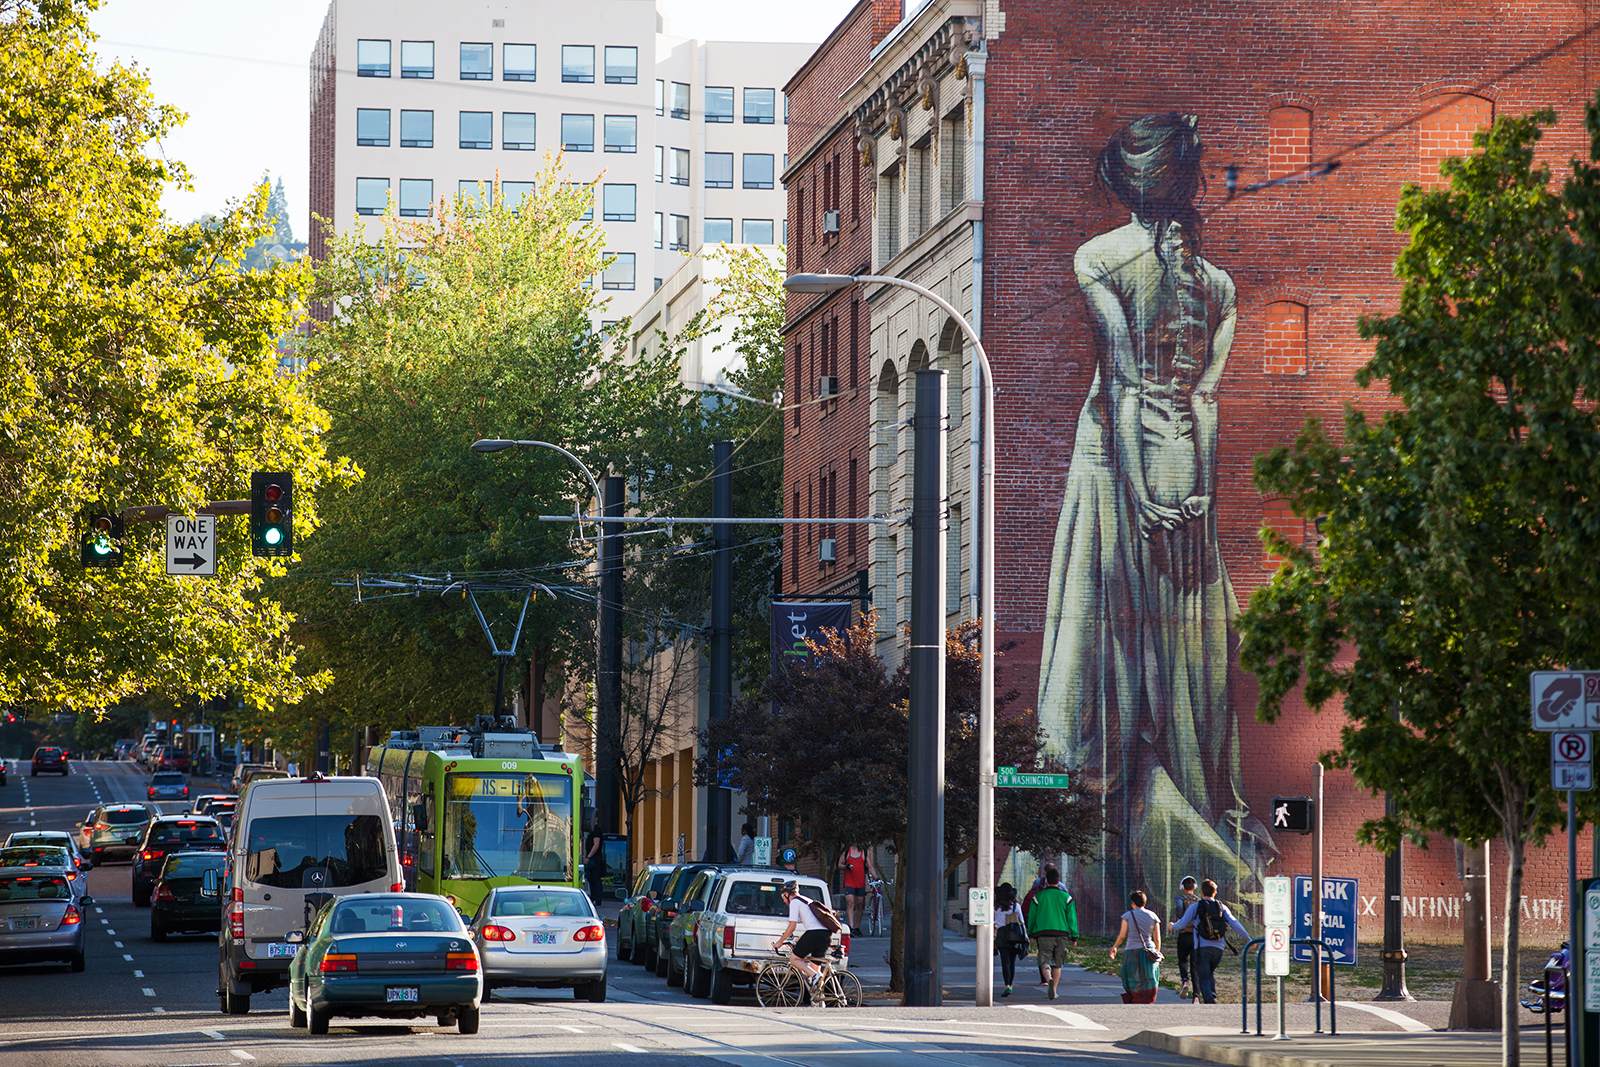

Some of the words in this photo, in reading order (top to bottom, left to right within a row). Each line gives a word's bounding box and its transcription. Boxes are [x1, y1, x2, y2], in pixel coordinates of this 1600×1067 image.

[175, 520, 208, 534] ONE
[174, 536, 208, 549] WAY
[501, 761, 518, 770] 009
[1001, 767, 1014, 775] 500
[998, 775, 1009, 784] SW
[1011, 775, 1054, 785] WASHINGTON
[482, 780, 496, 795] NS
[511, 780, 534, 796] LINE
[1325, 937, 1344, 946] DAY
[387, 990, 401, 1000] UPK
[405, 990, 418, 1000] 812
